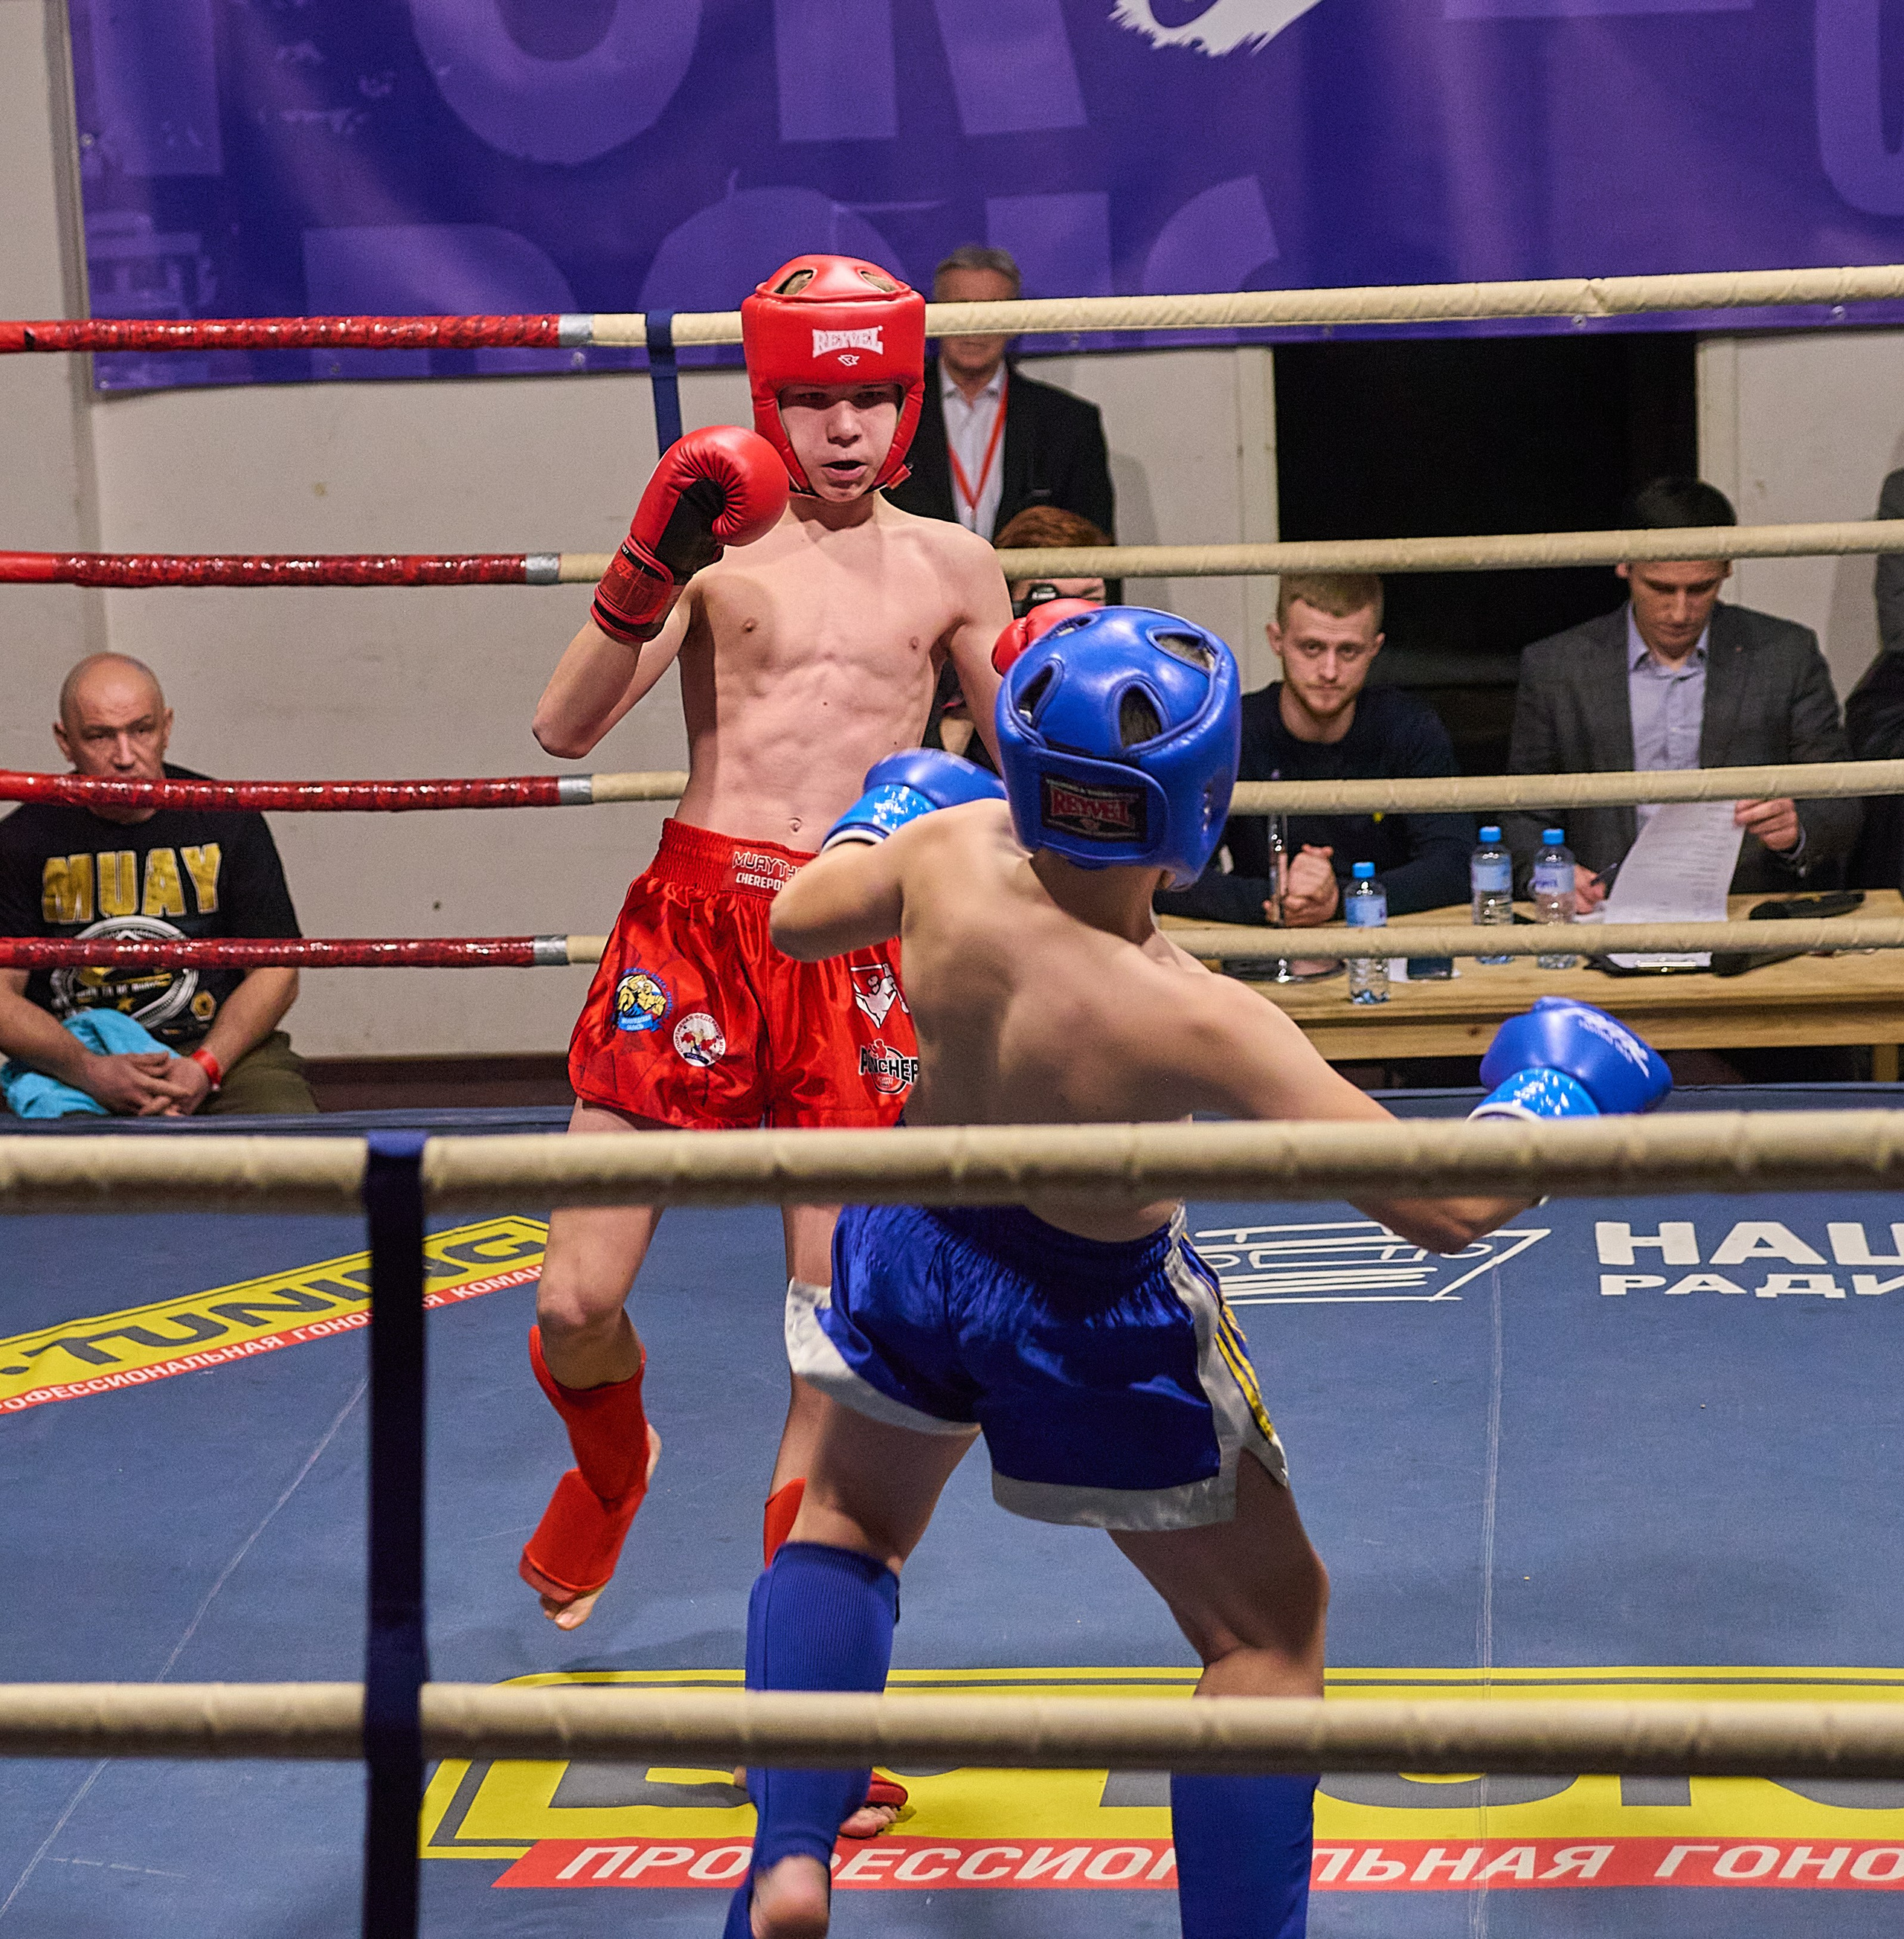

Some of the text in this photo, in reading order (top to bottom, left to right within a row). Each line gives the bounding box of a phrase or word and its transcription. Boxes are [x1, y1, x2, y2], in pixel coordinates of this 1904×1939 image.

[812, 326, 884, 358] REYVEL
[42, 842, 222, 925] MUAY
[0, 1336, 284, 1411] ОФЕССИОНАЛЬНАЯ
[1652, 1844, 1904, 1882] ГОНО
